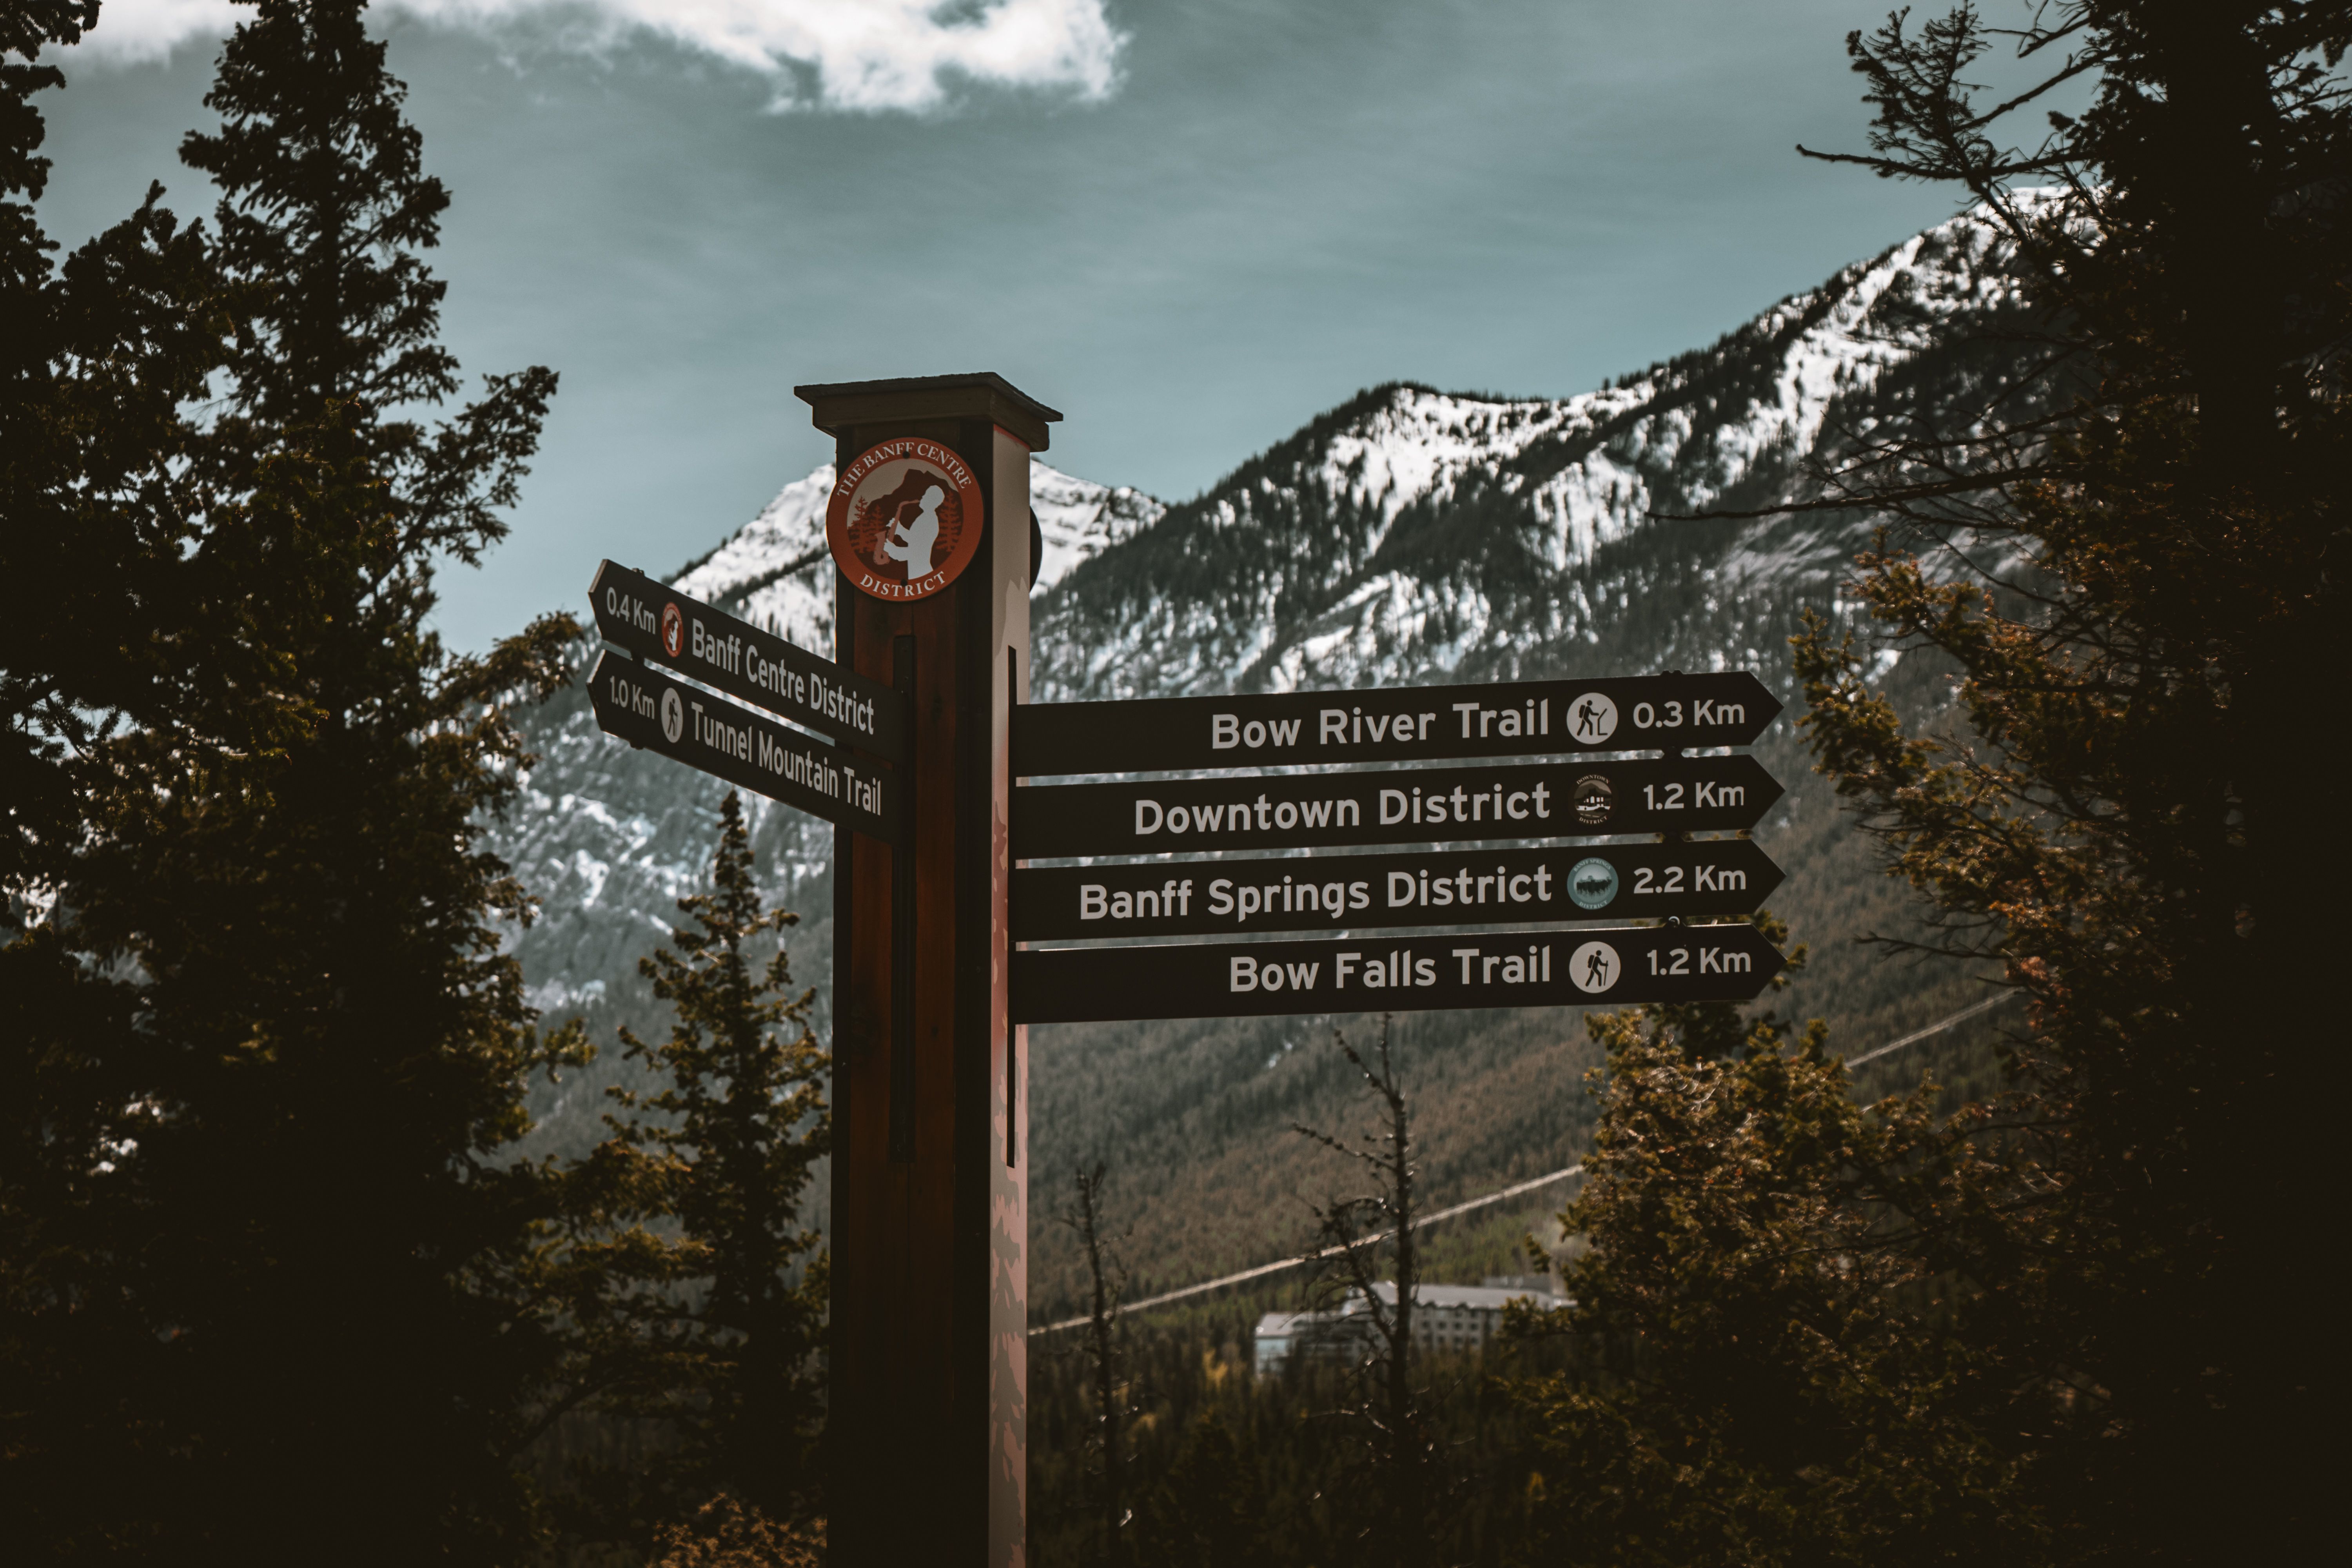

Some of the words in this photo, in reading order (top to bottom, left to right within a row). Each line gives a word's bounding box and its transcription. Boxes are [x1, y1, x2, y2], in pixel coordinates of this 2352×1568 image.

[837, 464, 866, 497] THE
[862, 442, 915, 469] BANFF
[917, 443, 972, 489] CENTRE
[860, 571, 945, 597] DISTRICT
[606, 586, 630, 619] 0.4
[633, 598, 656, 635] Km
[692, 618, 741, 675] Banff
[746, 644, 805, 704] Centre
[810, 672, 874, 735] District
[610, 675, 628, 708] 1.0
[632, 684, 655, 720] Km
[691, 701, 752, 763] Tunnel
[759, 730, 838, 799] Mountain
[843, 766, 881, 816] Trail
[1212, 713, 1302, 750] Bow
[1319, 706, 1437, 745] River
[1452, 698, 1548, 739] Trail
[1633, 701, 1683, 729] 0.3
[1694, 699, 1745, 726] Km
[1576, 775, 1610, 784] DOWNTOWN
[1135, 793, 1360, 835] Downtown
[1379, 781, 1550, 825] District
[1643, 782, 1684, 810] 1.2
[1695, 781, 1744, 808] Km
[1579, 815, 1608, 824] DISTRICT
[1080, 879, 1193, 920] Banff
[1207, 875, 1370, 923] Springs
[1387, 864, 1552, 907] District
[1633, 866, 1684, 894] 2.2
[1695, 865, 1746, 892] Km
[1230, 956, 1320, 993] Bow
[1336, 949, 1437, 989] Falls
[1452, 945, 1550, 985] Trail
[1647, 948, 1690, 976] 1.2
[1700, 947, 1751, 974] Km
